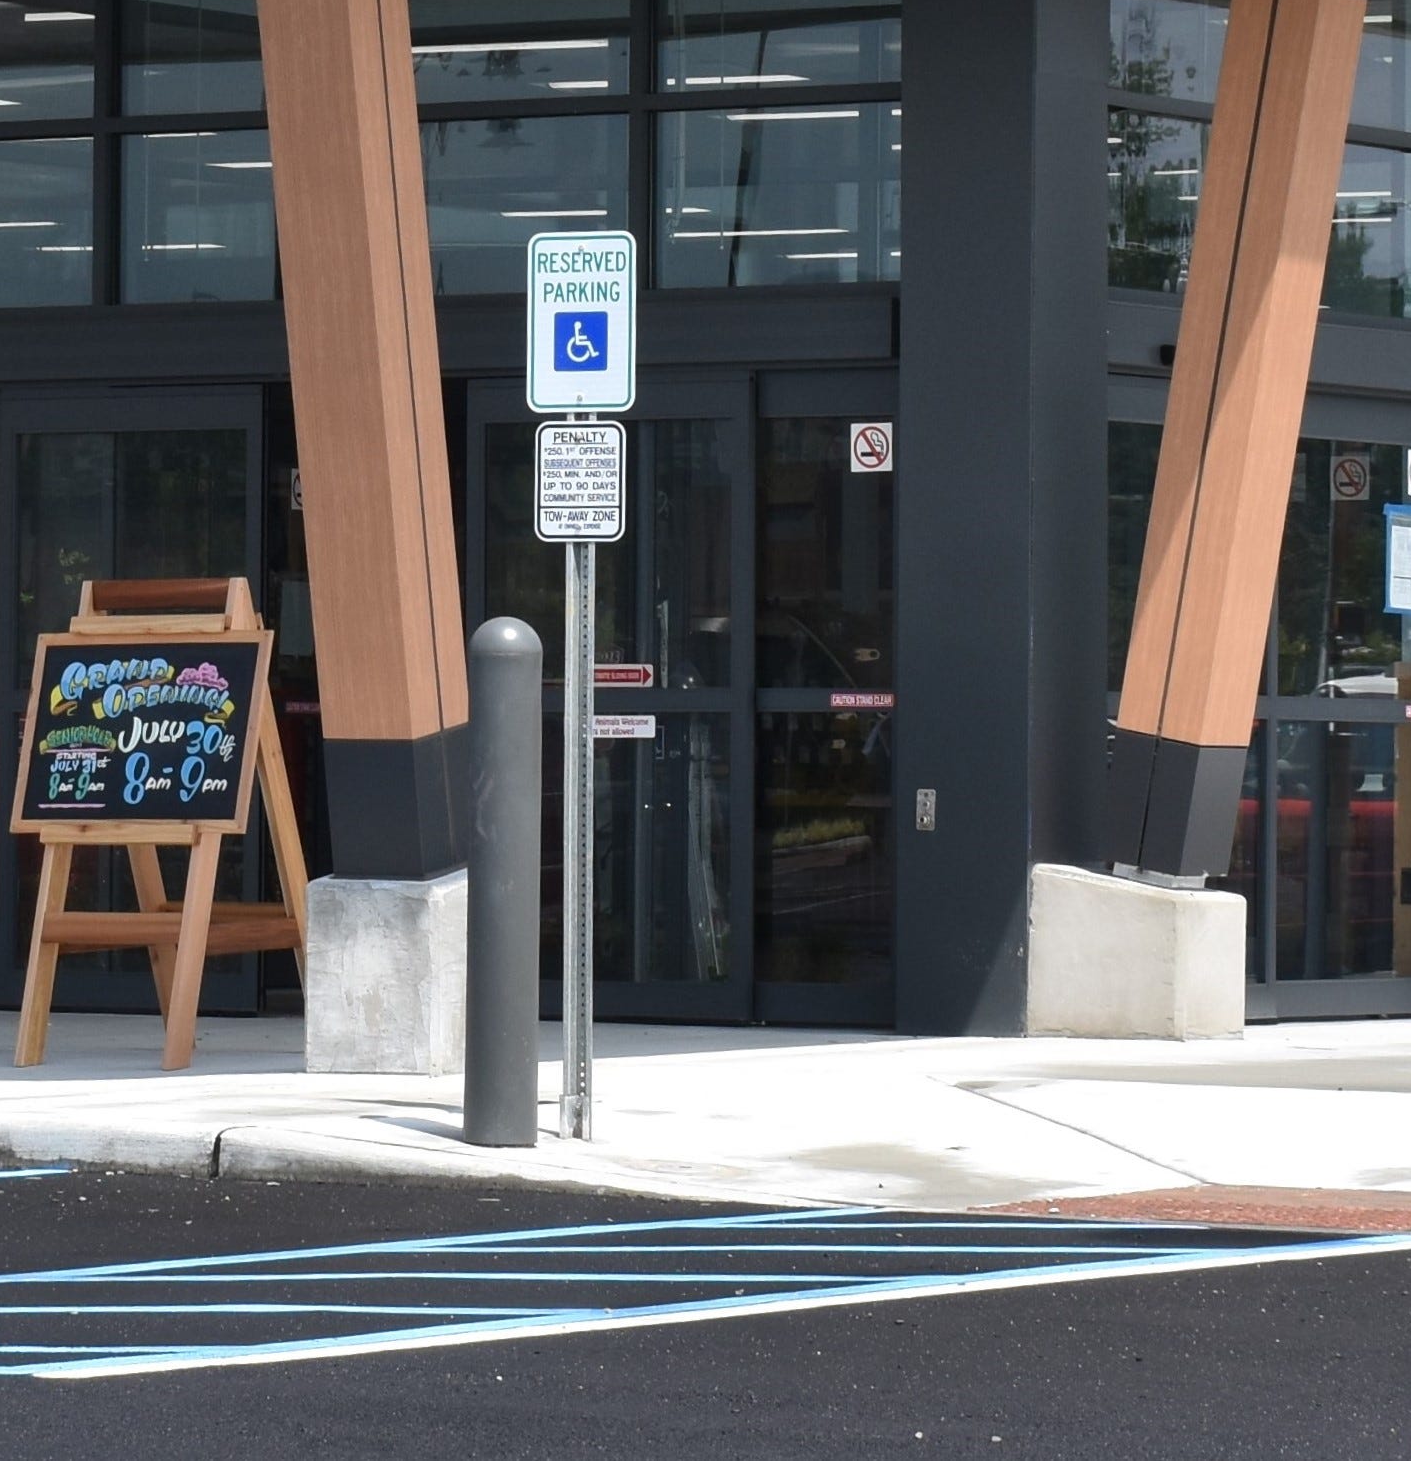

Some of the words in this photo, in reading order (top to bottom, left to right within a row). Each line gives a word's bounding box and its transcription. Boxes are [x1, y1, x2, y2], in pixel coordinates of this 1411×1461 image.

[537, 251, 627, 273] RESERVED
[543, 281, 621, 303] PARKING
[579, 447, 616, 455] OFFENSE
[543, 482, 556, 490] UP
[560, 482, 572, 490] TO
[576, 482, 588, 490] 90
[593, 482, 616, 490] DAYS
[543, 494, 584, 502] COMMUNITY
[587, 494, 616, 502] SERVICE
[544, 511, 589, 521] TOW-AWAY
[593, 511, 616, 521] ZONE
[61, 658, 168, 700] GRAND
[118, 716, 185, 753] JULY
[50, 758, 79, 772] JULY
